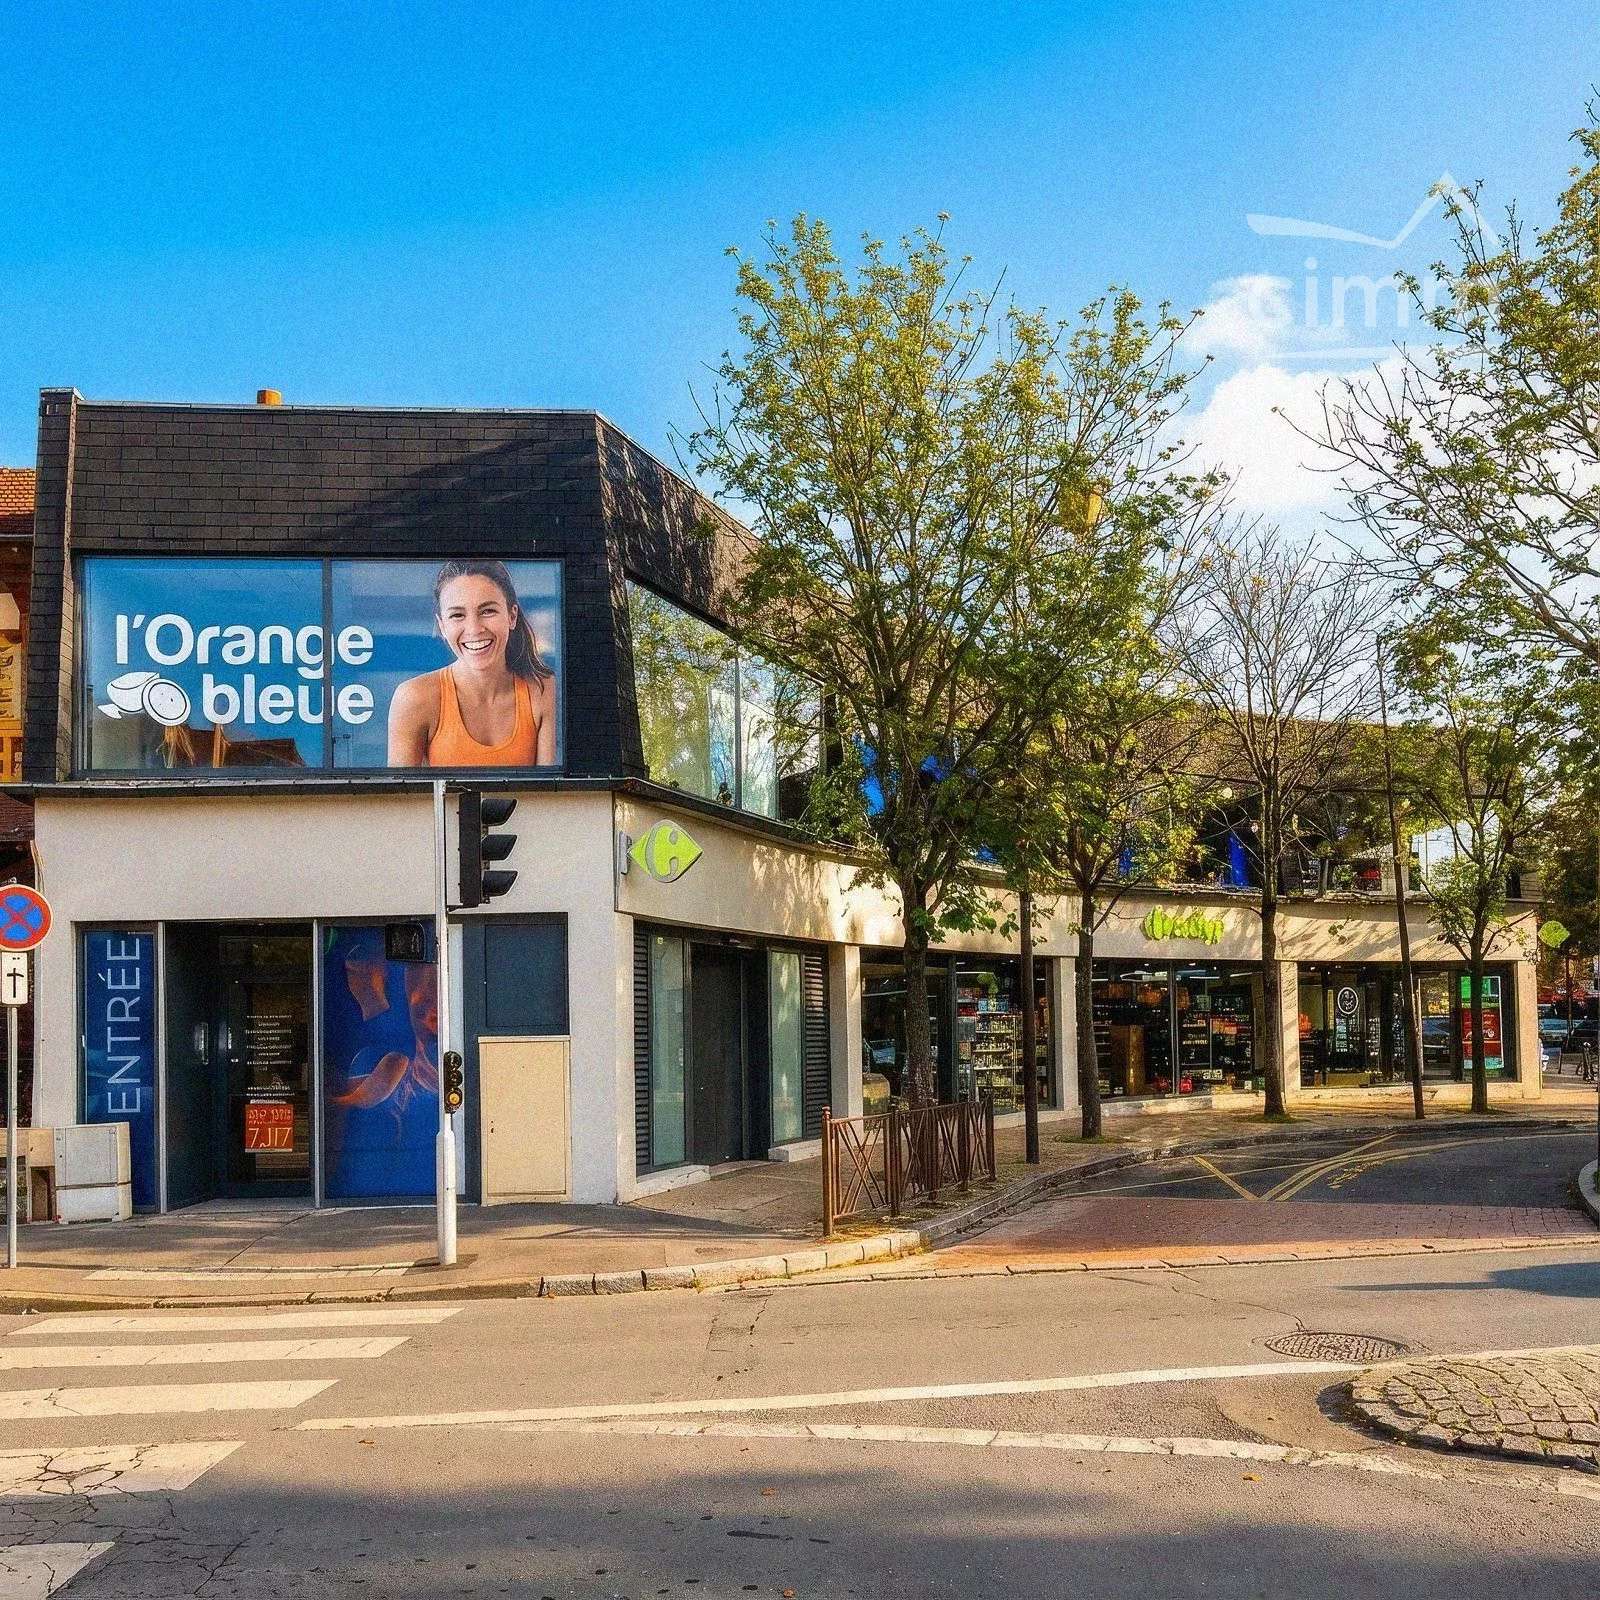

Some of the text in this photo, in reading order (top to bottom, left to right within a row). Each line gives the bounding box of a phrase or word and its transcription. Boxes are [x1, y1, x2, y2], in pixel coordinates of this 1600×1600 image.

[115, 613, 374, 680] l'Orange
[203, 673, 374, 724] bleue
[98, 938, 141, 1113] ENTRÉE
